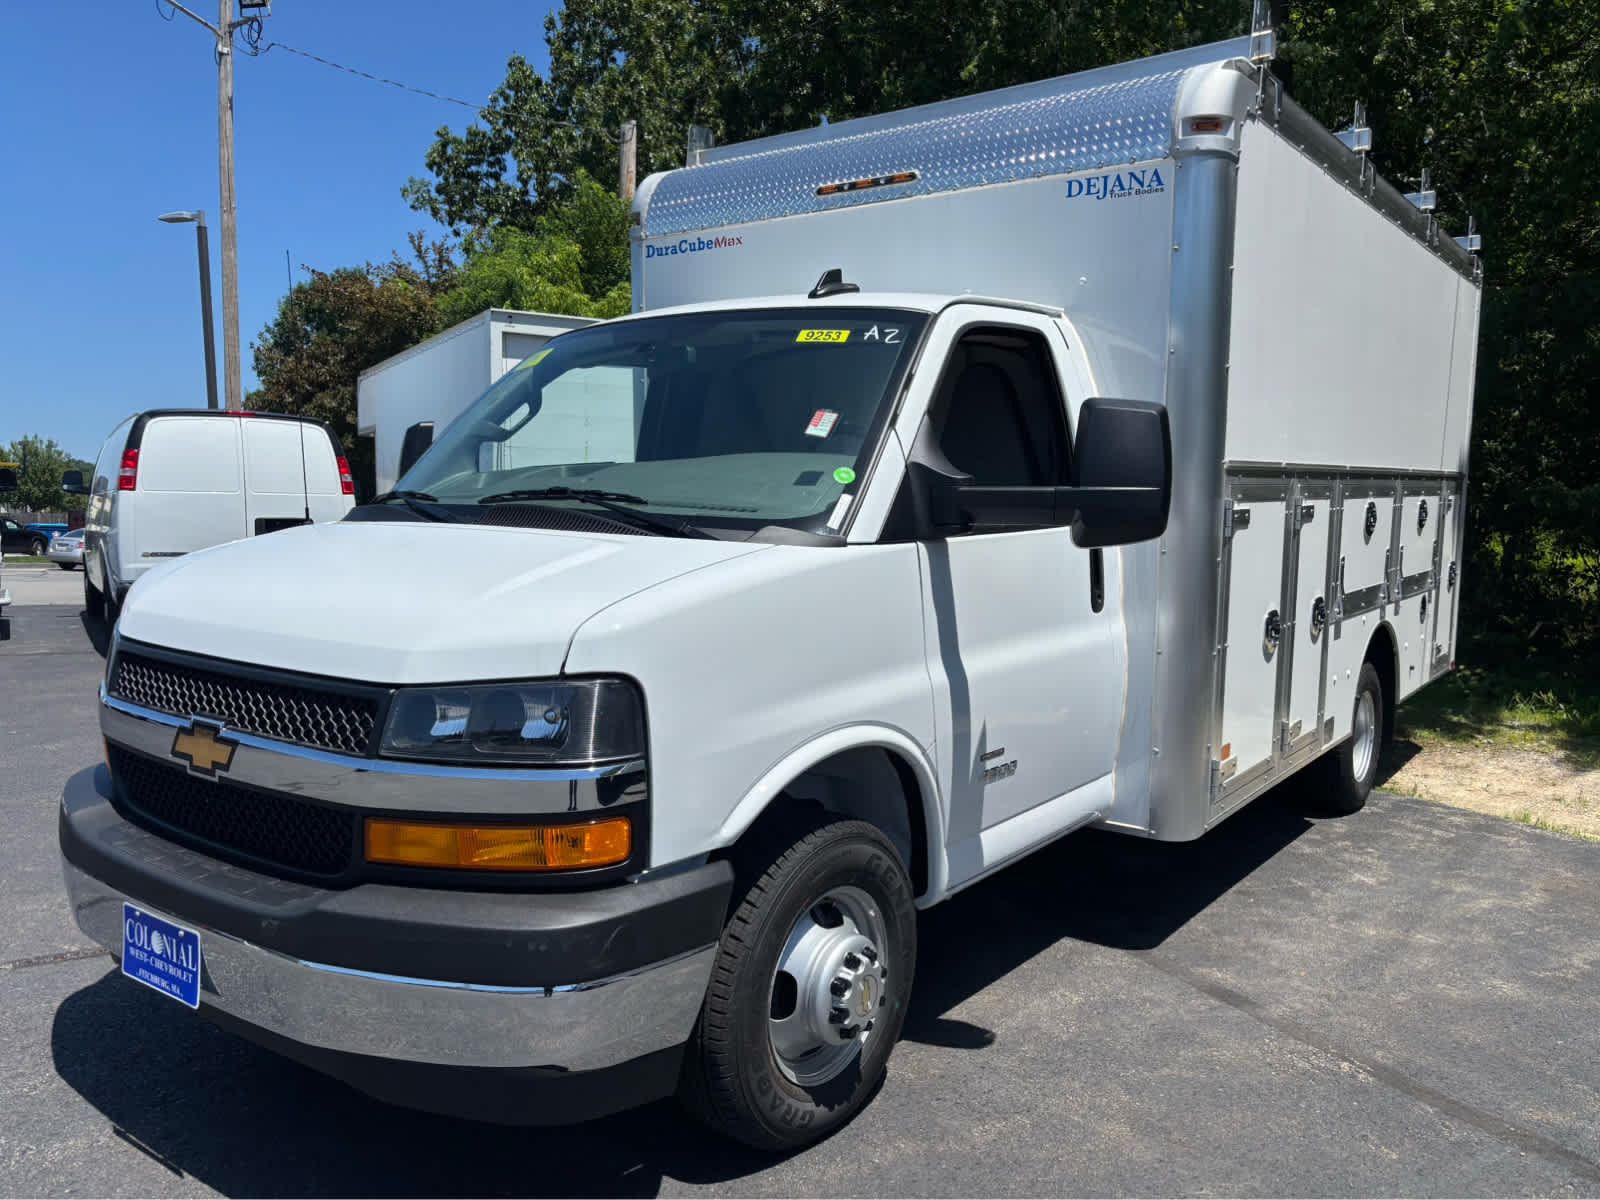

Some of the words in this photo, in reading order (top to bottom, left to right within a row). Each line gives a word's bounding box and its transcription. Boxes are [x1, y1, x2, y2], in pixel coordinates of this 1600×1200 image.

[1065, 167, 1165, 200] DEJANA
[1110, 189, 1132, 199] Truck
[1135, 186, 1165, 196] Bodies
[804, 330, 842, 341] 9253
[126, 918, 197, 972] COLONIAL
